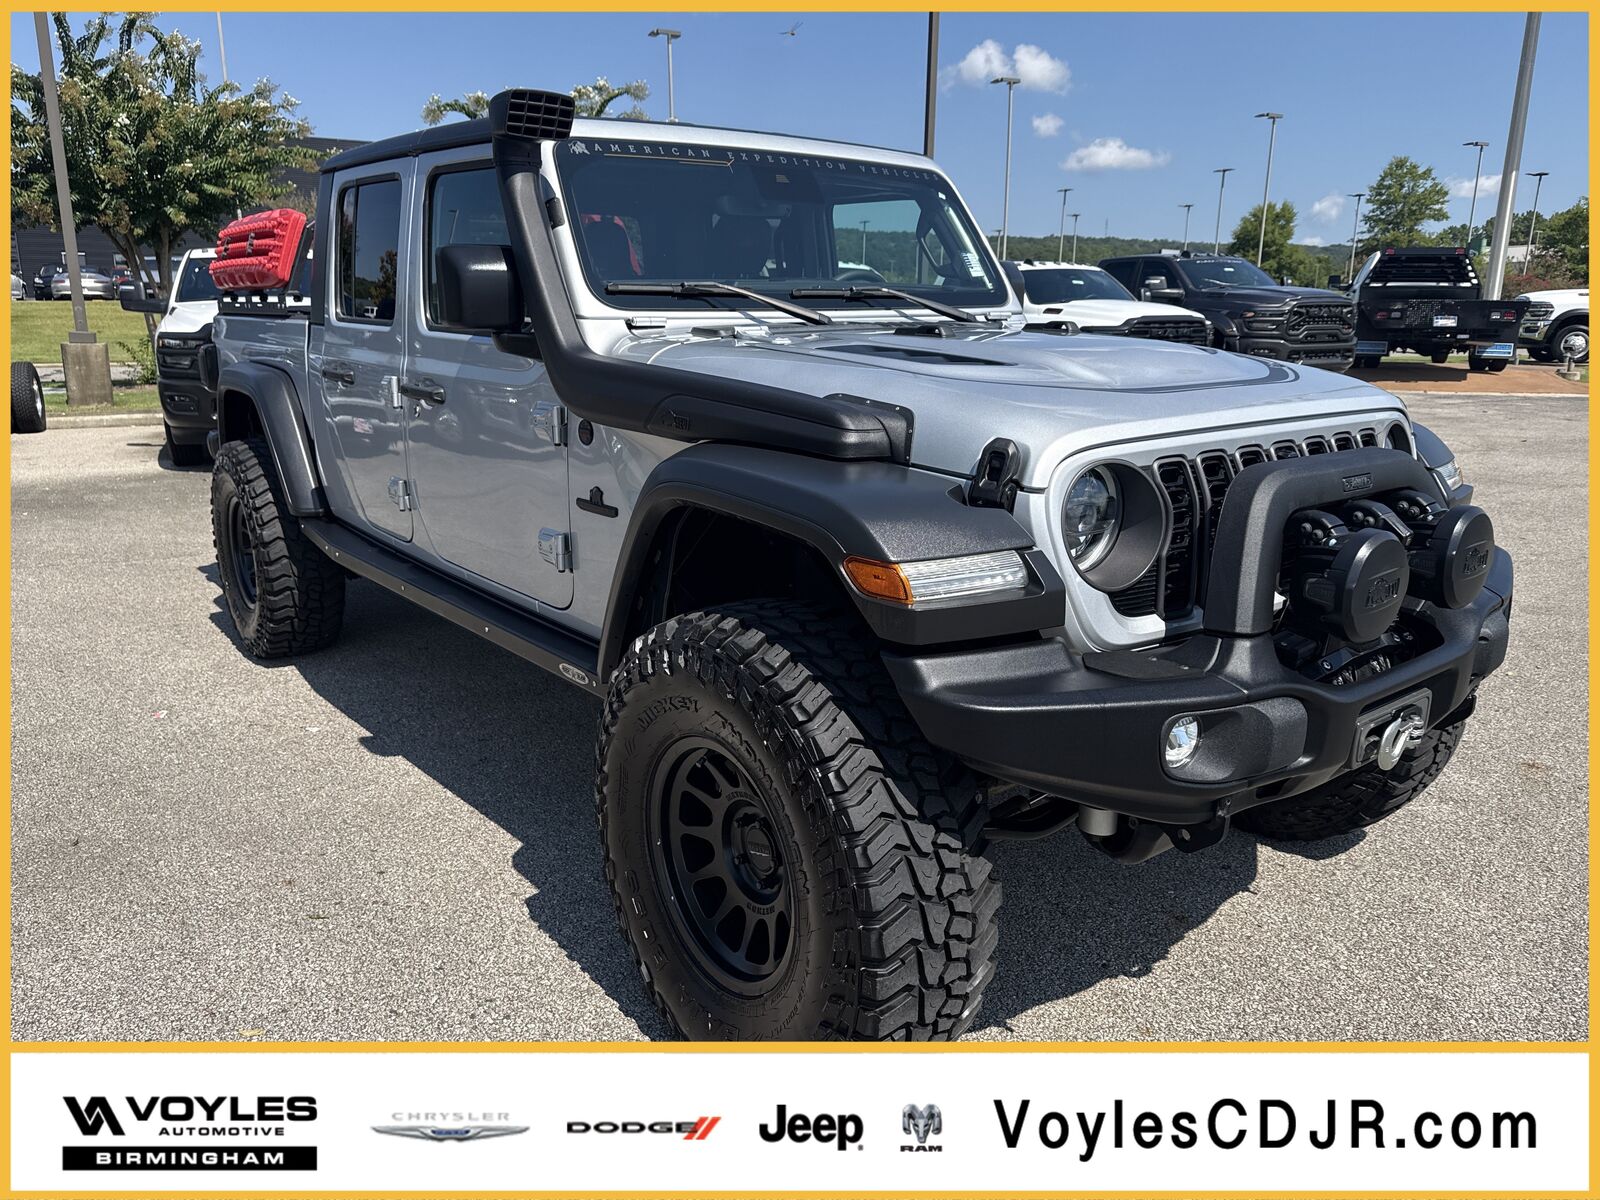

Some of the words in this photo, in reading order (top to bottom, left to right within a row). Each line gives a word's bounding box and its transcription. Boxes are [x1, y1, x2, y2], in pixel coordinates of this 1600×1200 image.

[593, 143, 711, 158] AMERICAN
[727, 151, 847, 171] EXPEDITION
[859, 165, 940, 181] VEHICLES
[637, 695, 702, 731] MICKEY
